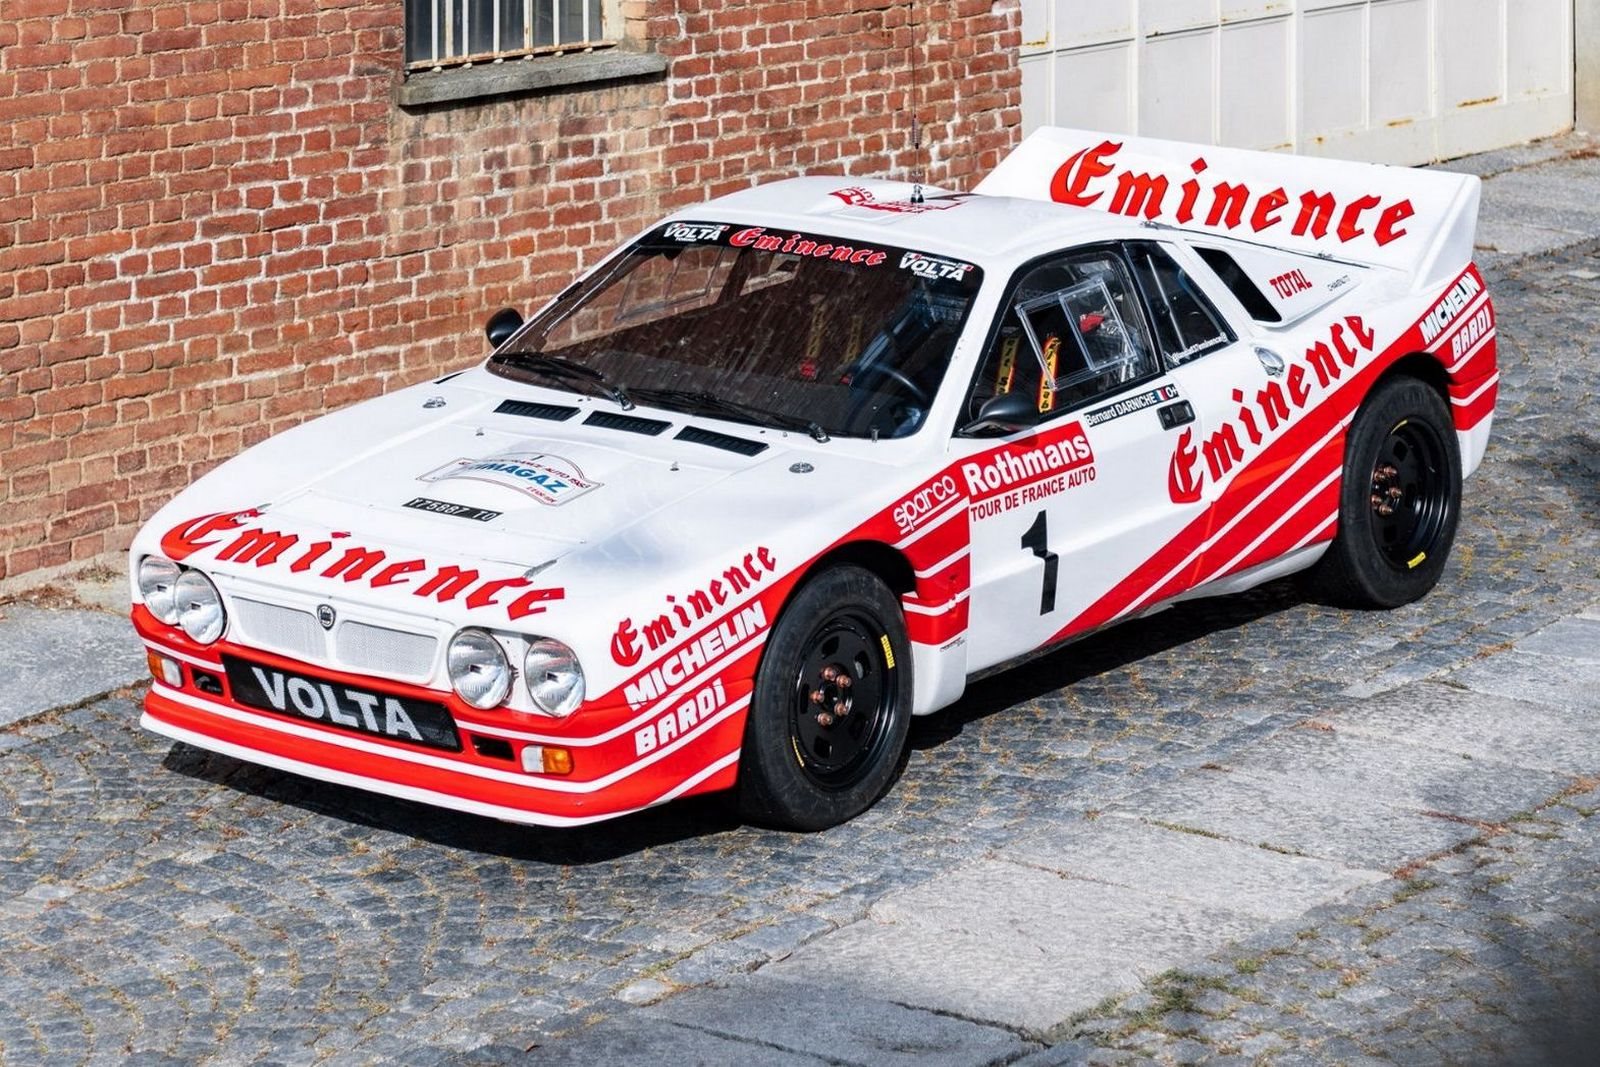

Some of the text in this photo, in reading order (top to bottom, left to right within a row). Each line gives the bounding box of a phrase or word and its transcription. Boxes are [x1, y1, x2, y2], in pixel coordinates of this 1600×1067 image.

[1049, 140, 1415, 247] Eminence
[664, 225, 722, 241] VOLTA
[729, 227, 887, 267] Eminence
[899, 256, 965, 281] VOLTA
[1269, 268, 1313, 300] TOTAL
[1418, 271, 1481, 345] MICHELIN
[1451, 304, 1492, 362] BARDI
[1085, 405, 1117, 426] Bernard
[1115, 392, 1158, 416] DARNICHE
[1168, 315, 1374, 504] Eminence
[961, 434, 1091, 497] Rothmans
[970, 466, 1097, 523] TOUR DE FRANCE AUTO
[893, 474, 955, 531] sparco
[160, 507, 566, 622] Eminence
[1021, 509, 1059, 616] 1
[610, 546, 777, 667] Eminence
[623, 600, 768, 712] MICHELIN
[249, 666, 424, 742] VOLTA
